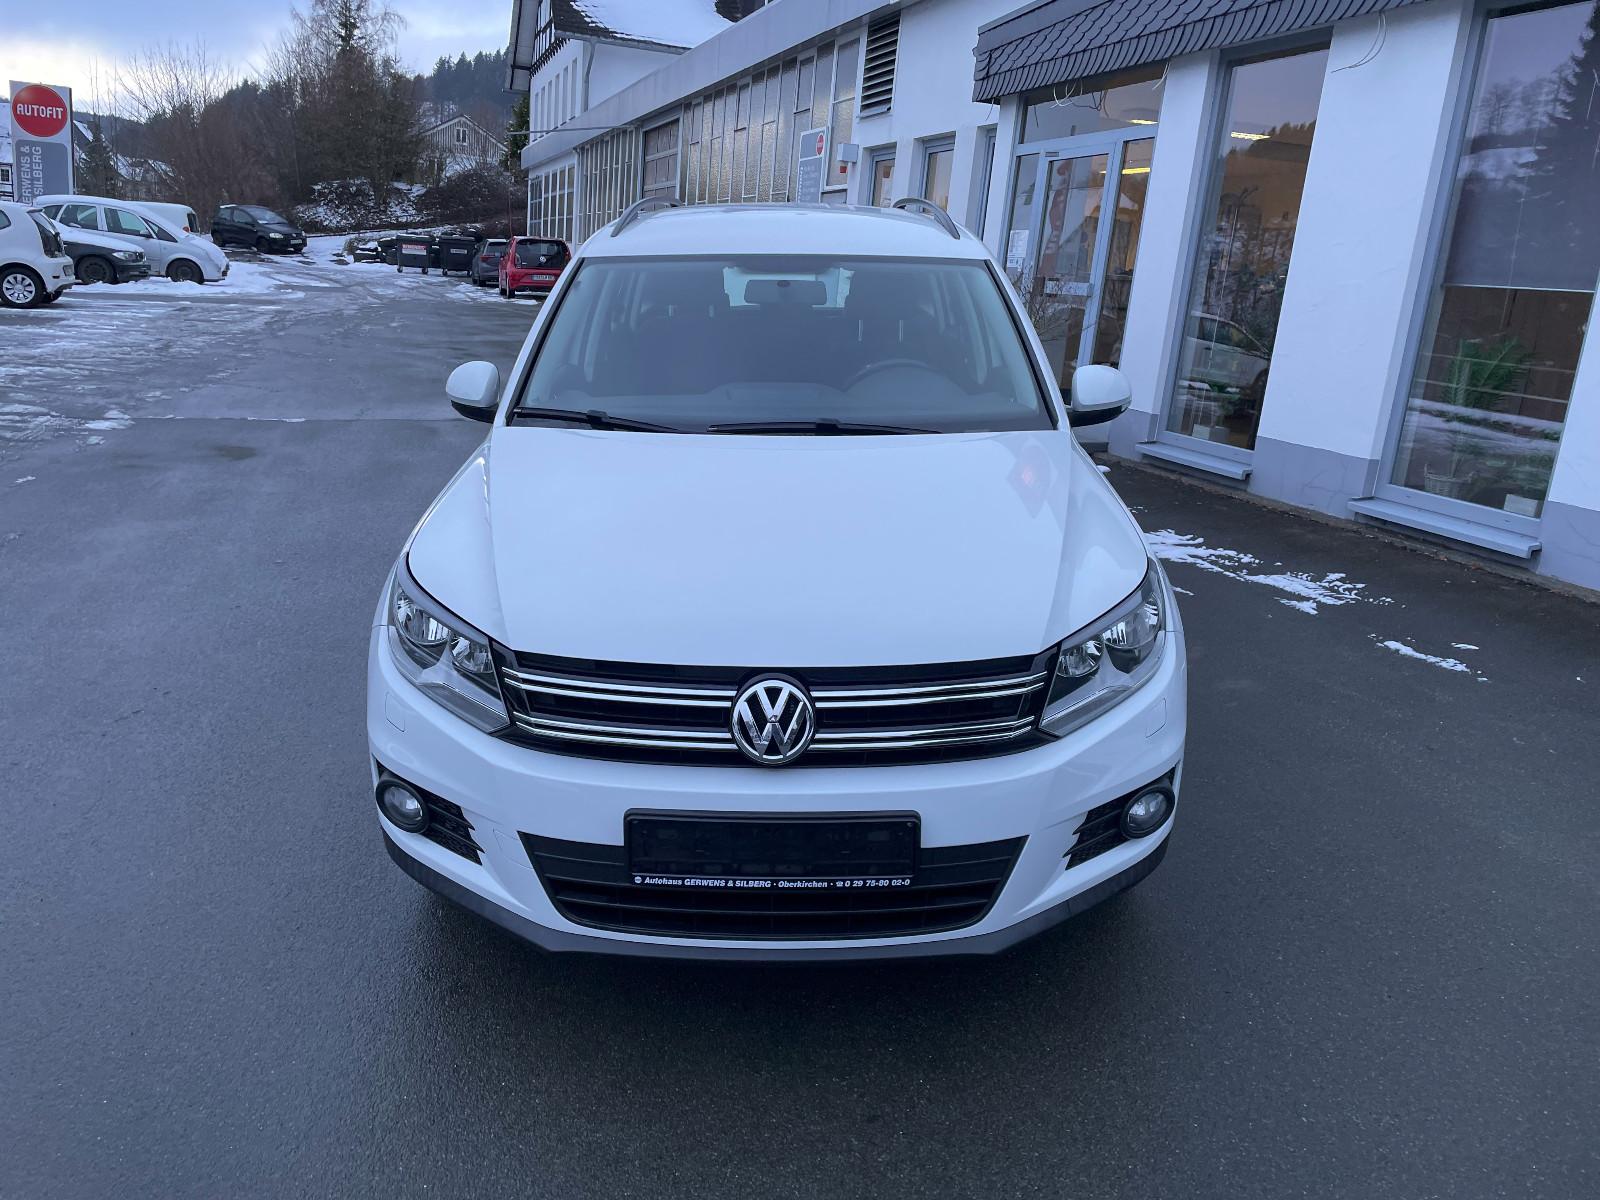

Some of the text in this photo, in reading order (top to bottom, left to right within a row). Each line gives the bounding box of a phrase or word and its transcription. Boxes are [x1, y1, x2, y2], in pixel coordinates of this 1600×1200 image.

[16, 103, 64, 120] AUTOFIT
[20, 145, 32, 204] ERWENS &
[32, 146, 43, 195] SILBERG
[732, 679, 814, 763] VW
[644, 876, 682, 886] Autohaus
[684, 878, 726, 887] GERWENS
[727, 879, 734, 887] &
[735, 880, 772, 888] SILBERG
[778, 880, 828, 888] Oberkirchen
